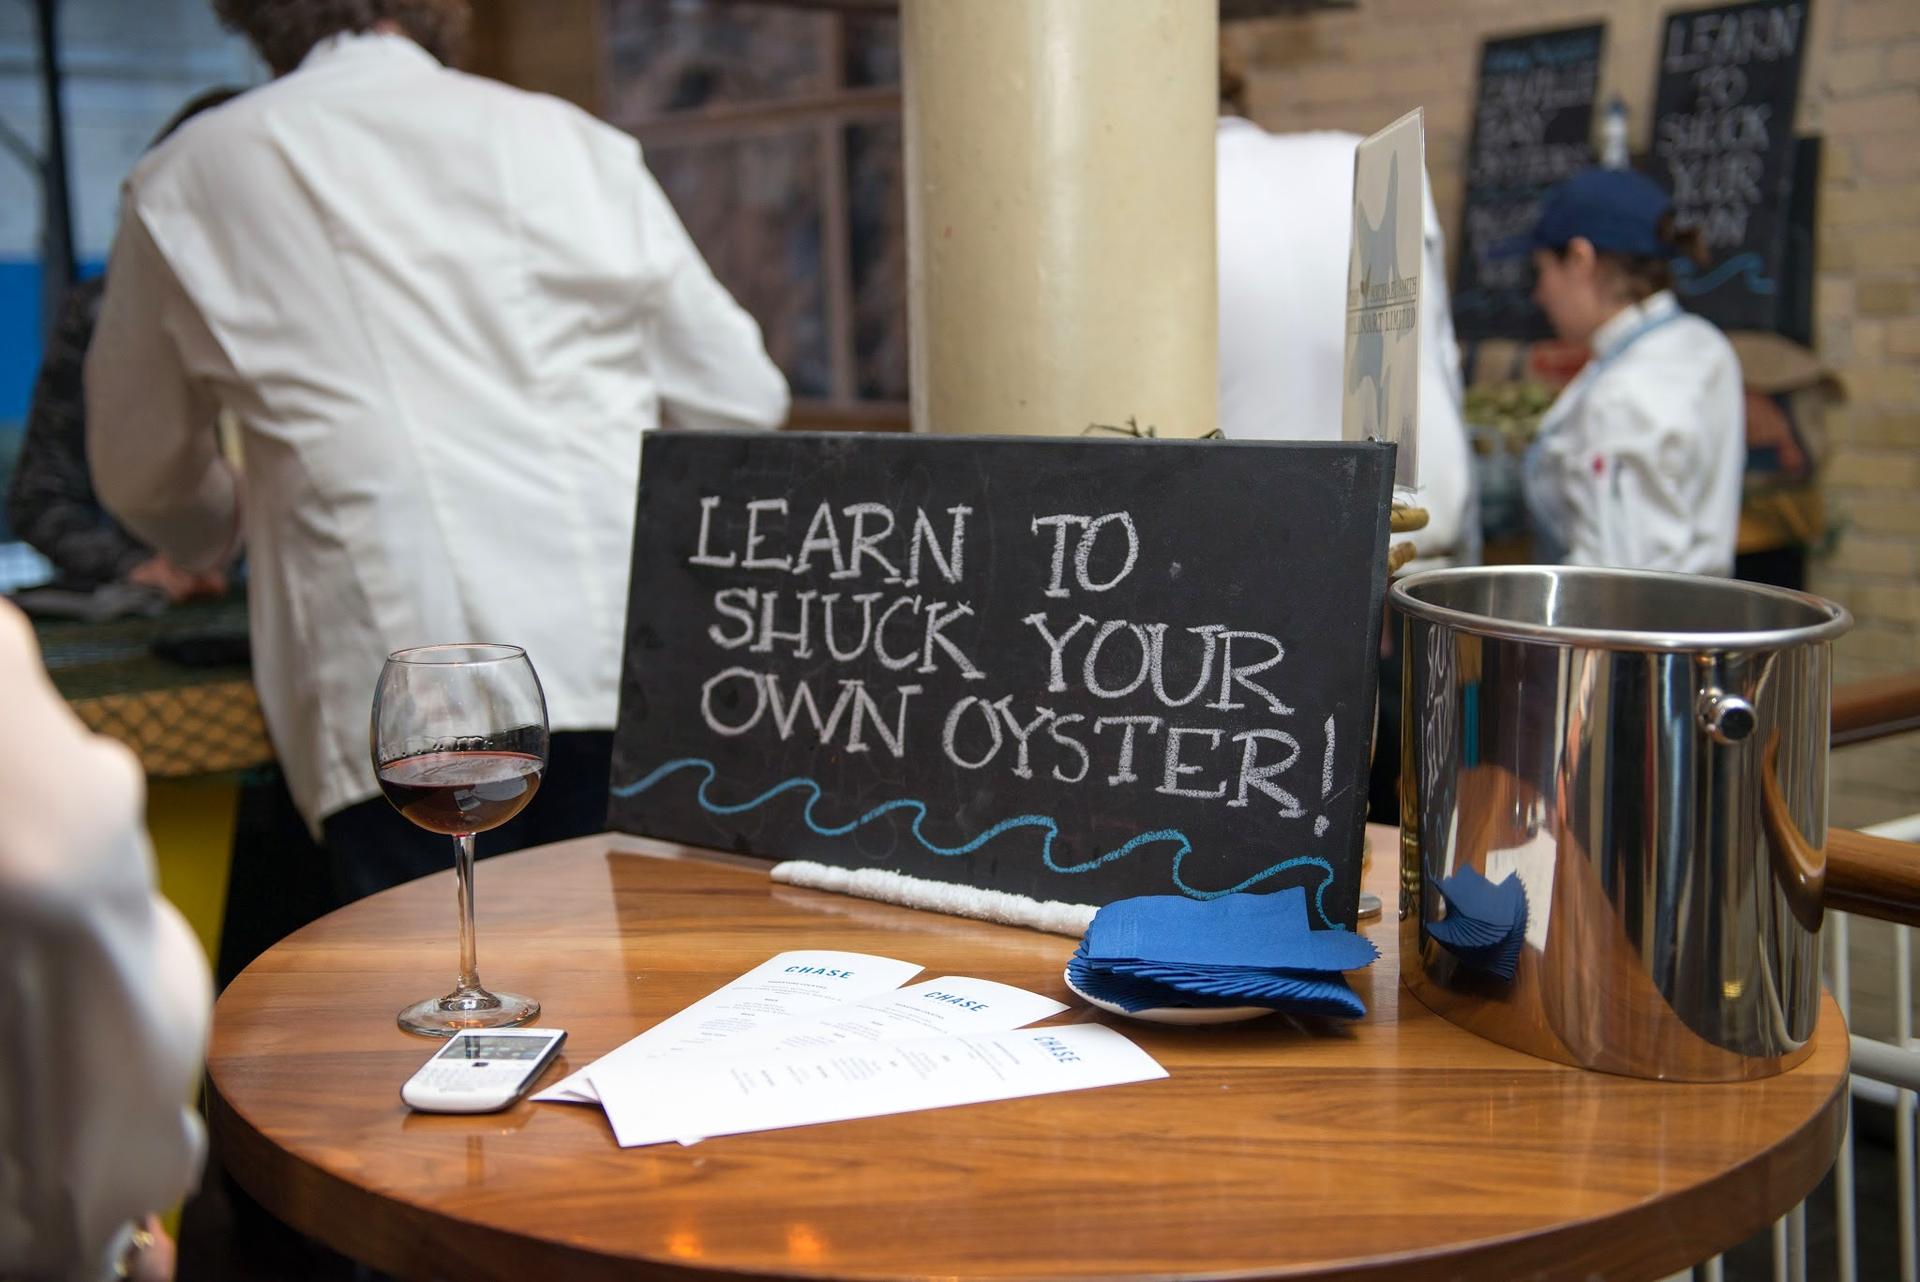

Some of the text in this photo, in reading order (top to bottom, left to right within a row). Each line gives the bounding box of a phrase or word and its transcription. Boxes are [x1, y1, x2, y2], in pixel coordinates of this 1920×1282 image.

[689, 495, 1140, 598] LEARN TO
[708, 587, 1295, 716] SHUCK YOUR
[700, 666, 924, 758] OWN
[942, 693, 1337, 837] OYSTER!
[784, 965, 855, 980] CHASE
[924, 990, 989, 1013] CHASE
[1033, 1036, 1081, 1063] CHASE
